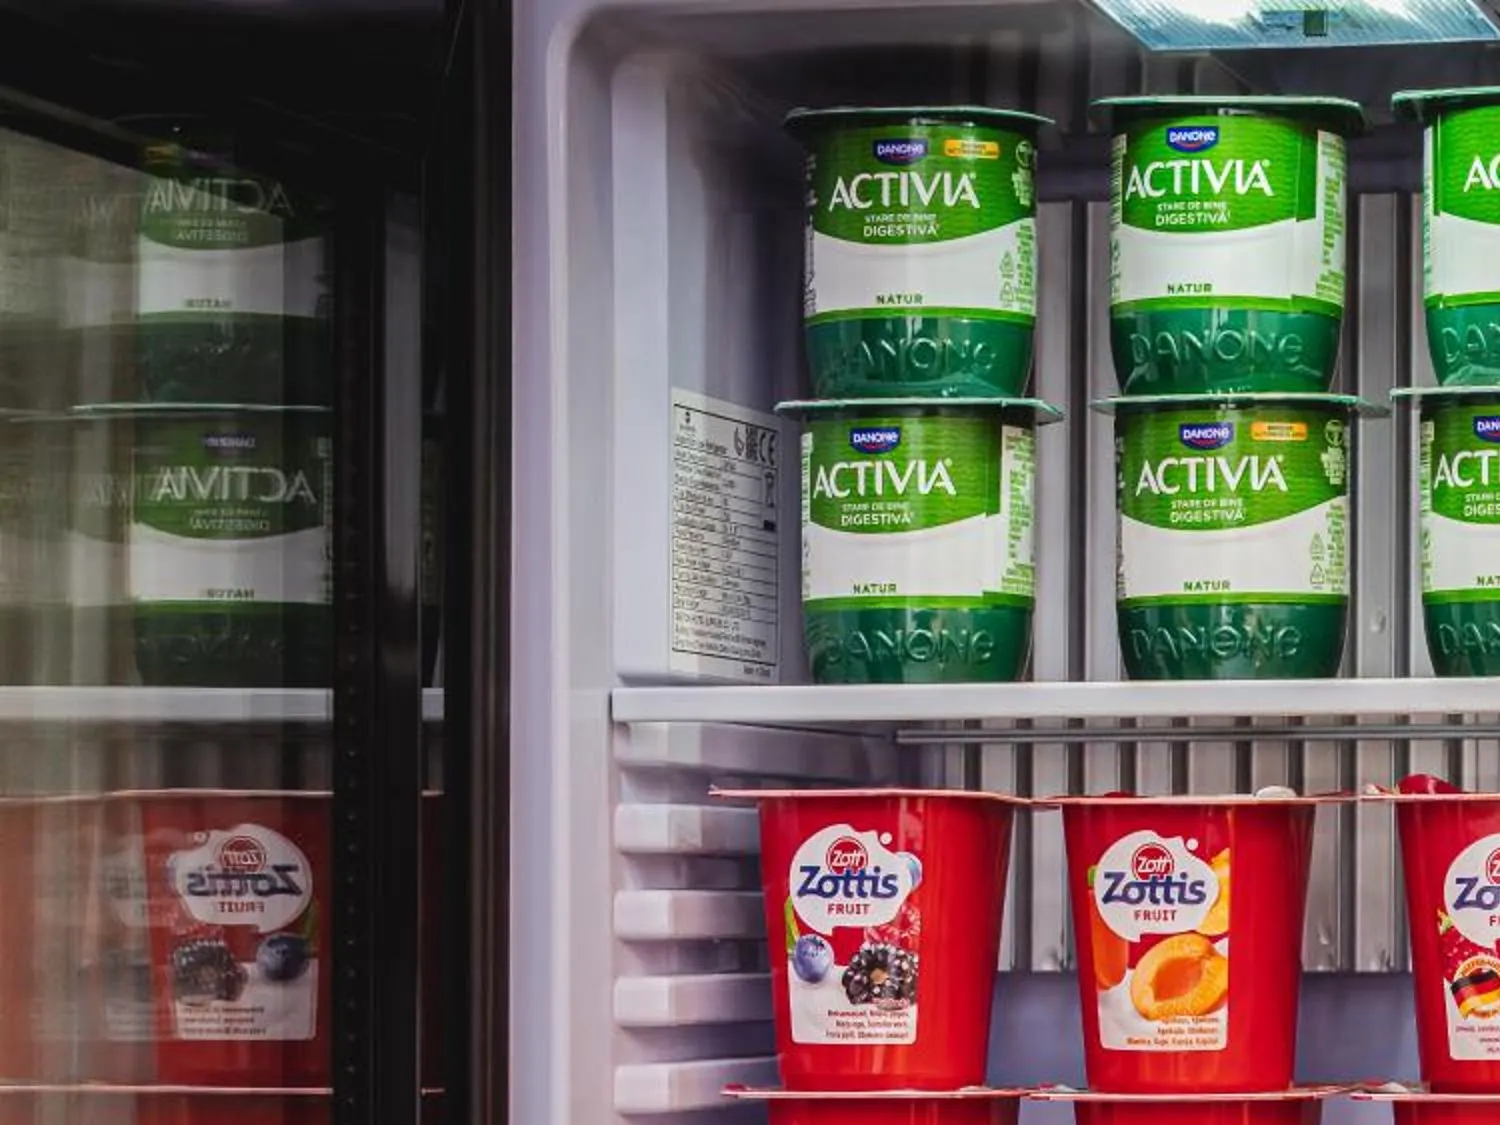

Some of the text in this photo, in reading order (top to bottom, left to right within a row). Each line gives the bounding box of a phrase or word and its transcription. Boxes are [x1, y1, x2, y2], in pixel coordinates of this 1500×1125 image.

[1125, 159, 1274, 202] ACTIVIA
[828, 171, 981, 212] ACTIVIA
[1167, 282, 1213, 295] NATUR
[876, 294, 924, 305] NATUR
[812, 458, 957, 499] ACTIVIA
[1135, 455, 1289, 497] ACTIVIA
[852, 583, 897, 595] NATUR
[1183, 580, 1231, 591] NATUR
[831, 851, 863, 867] Zott
[1138, 857, 1173, 873] Zott
[797, 865, 899, 899] Zottis
[1101, 871, 1207, 905] Zottis
[827, 903, 871, 915] FRUIT
[1134, 909, 1178, 921] FRUIT
